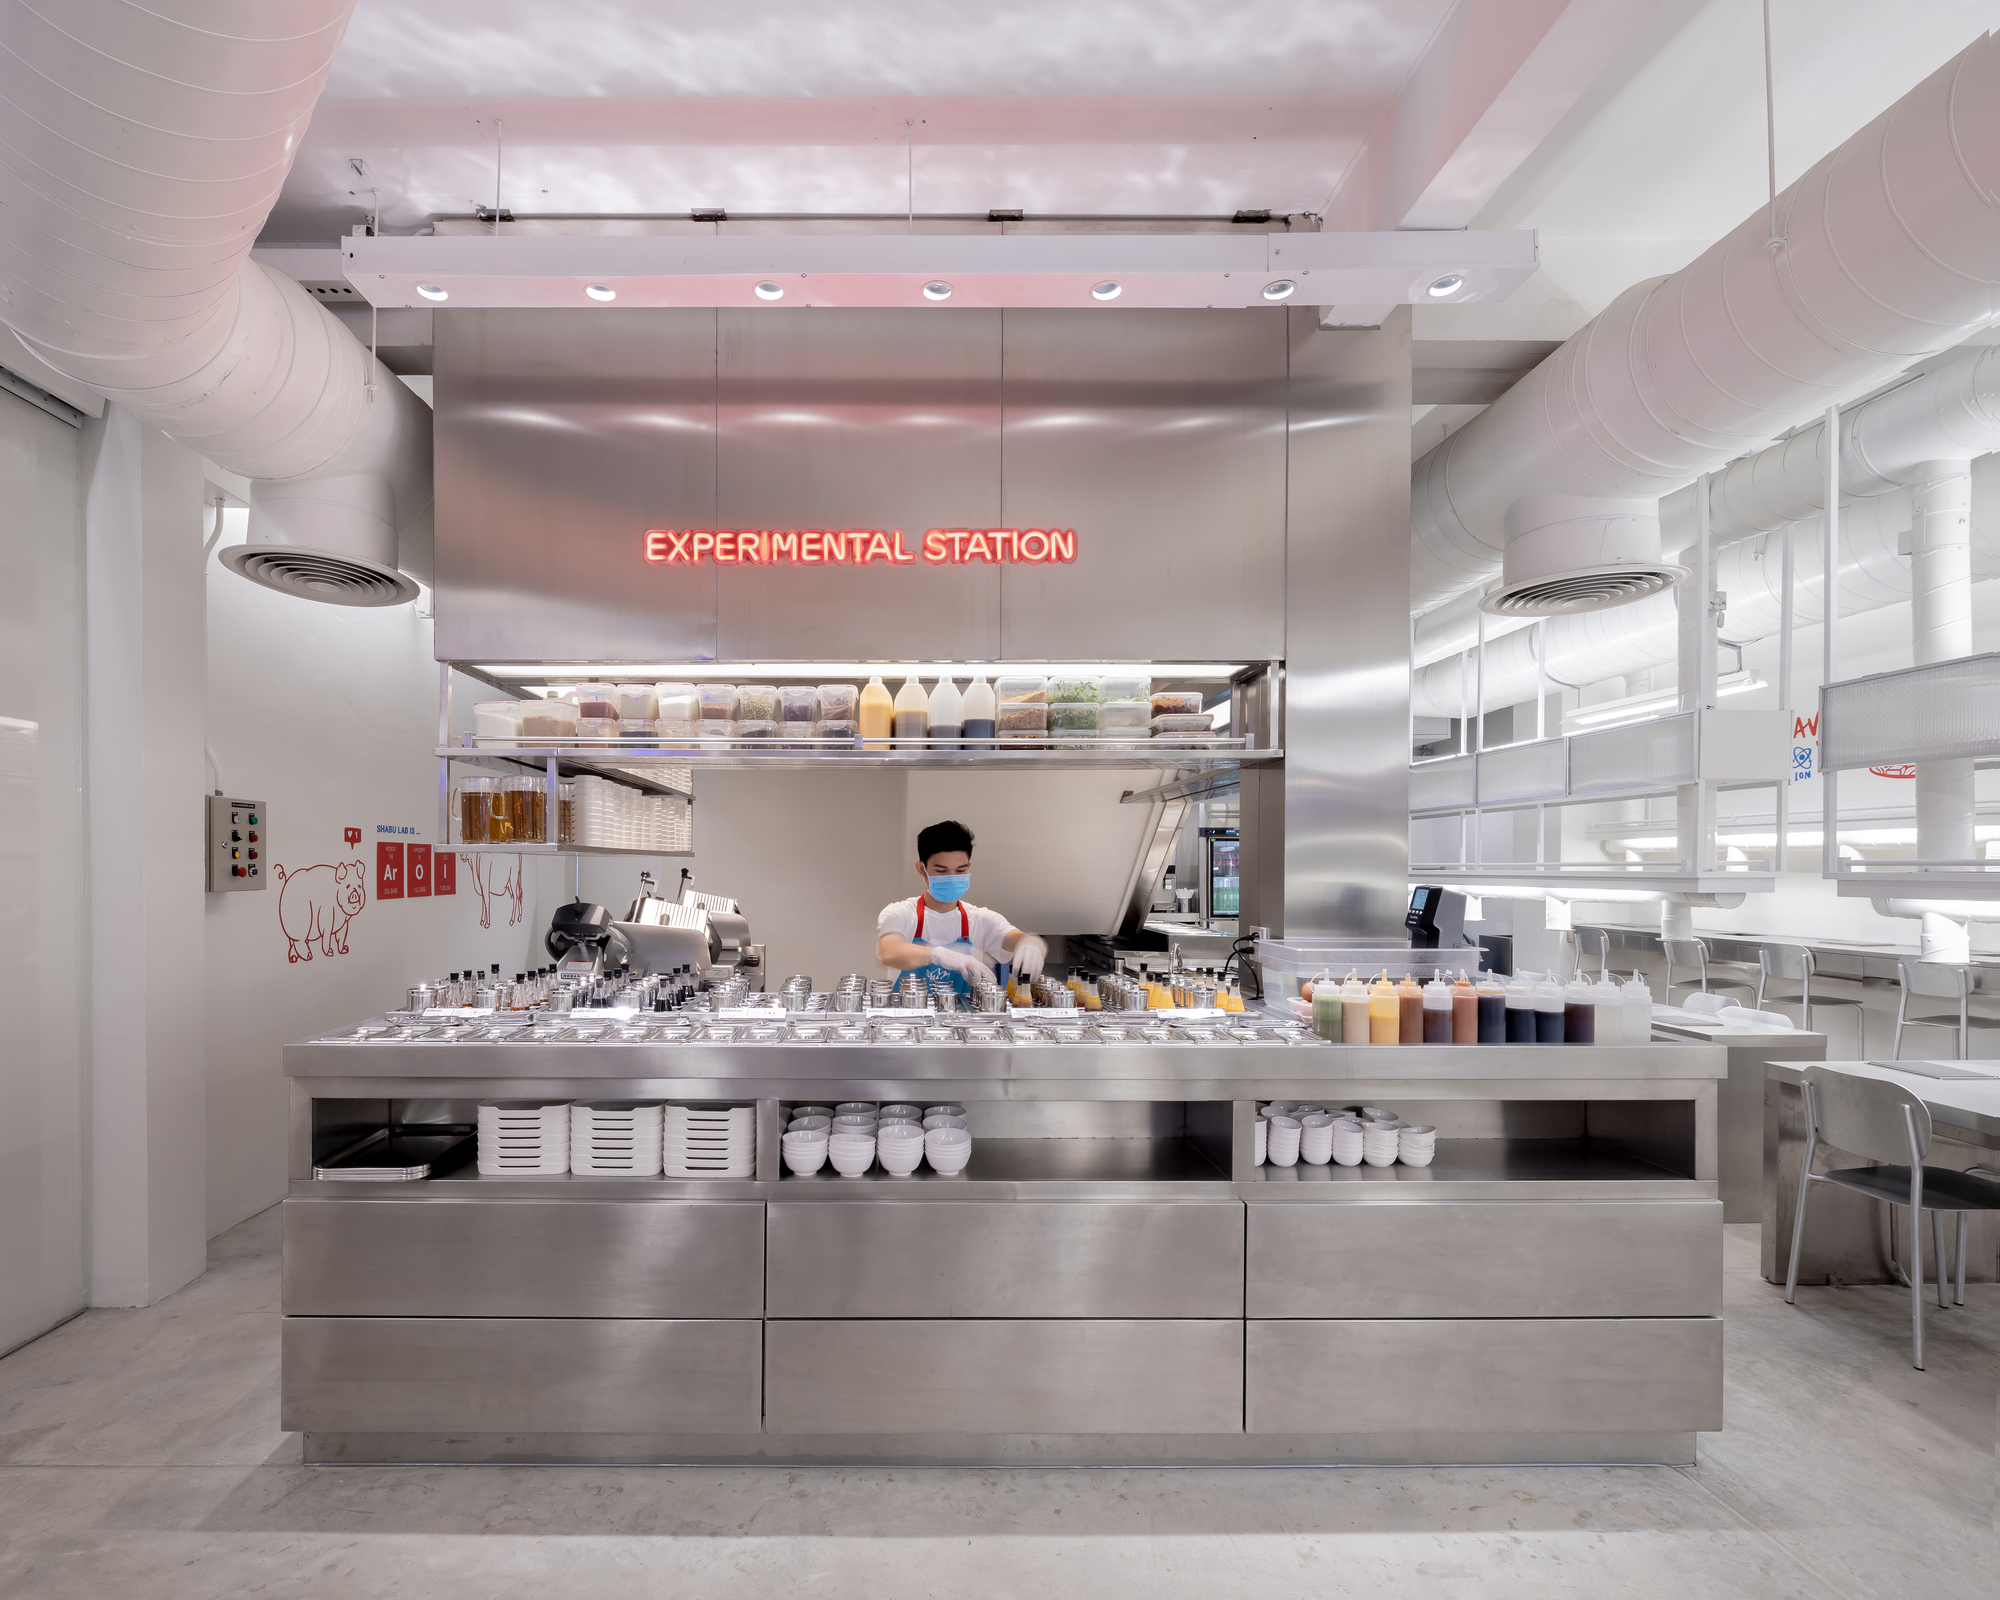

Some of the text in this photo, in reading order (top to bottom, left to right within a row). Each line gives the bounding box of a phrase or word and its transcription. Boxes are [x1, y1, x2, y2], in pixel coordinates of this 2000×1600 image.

[646, 529, 1077, 563] EXPERIMENTAL STATION
[1794, 770, 1811, 781] ION
[354, 830, 358, 839] 1
[376, 825, 397, 834] SHABU
[397, 826, 409, 835] LAB
[409, 826, 416, 835] IS
[383, 864, 398, 880] Ar
[415, 864, 424, 880] O
[443, 864, 447, 879] I
